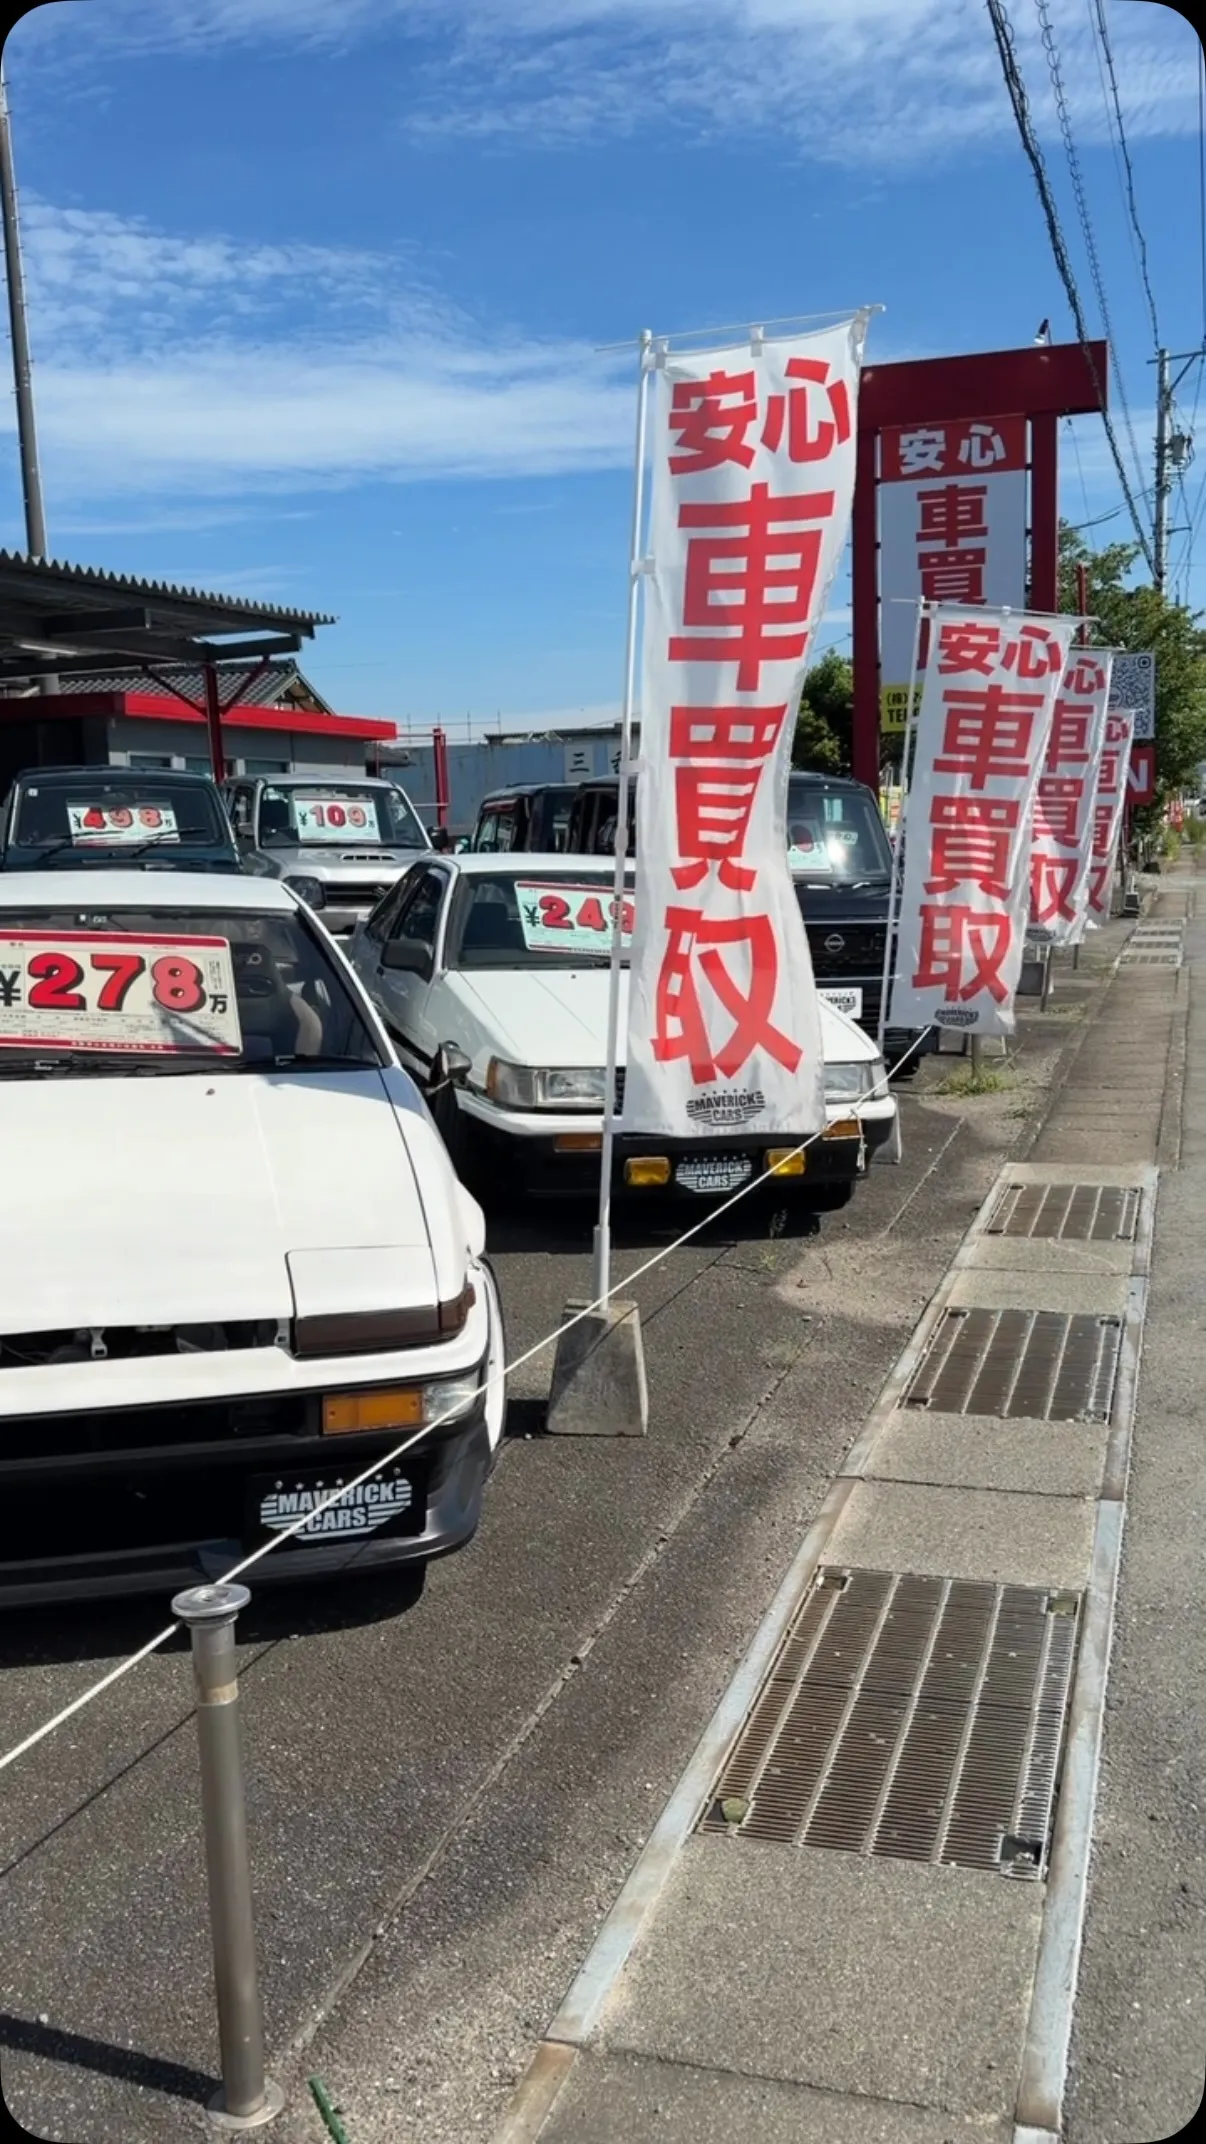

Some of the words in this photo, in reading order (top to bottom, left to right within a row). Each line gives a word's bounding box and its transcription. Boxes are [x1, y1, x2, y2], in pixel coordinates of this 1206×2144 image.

[668, 357, 851, 476] 安心
[899, 424, 1006, 475] 安心
[938, 622, 1062, 679] 安心
[650, 482, 835, 1085] 車買取
[911, 684, 1044, 1003] 車買取
[694, 1093, 756, 1111] MAVERICK
[713, 1108, 743, 1121] CARS
[683, 1161, 742, 1175] MAVERICK
[698, 1175, 729, 1189] CARS
[278, 1481, 396, 1514] MAVERICK
[306, 1507, 367, 1533] CARS
